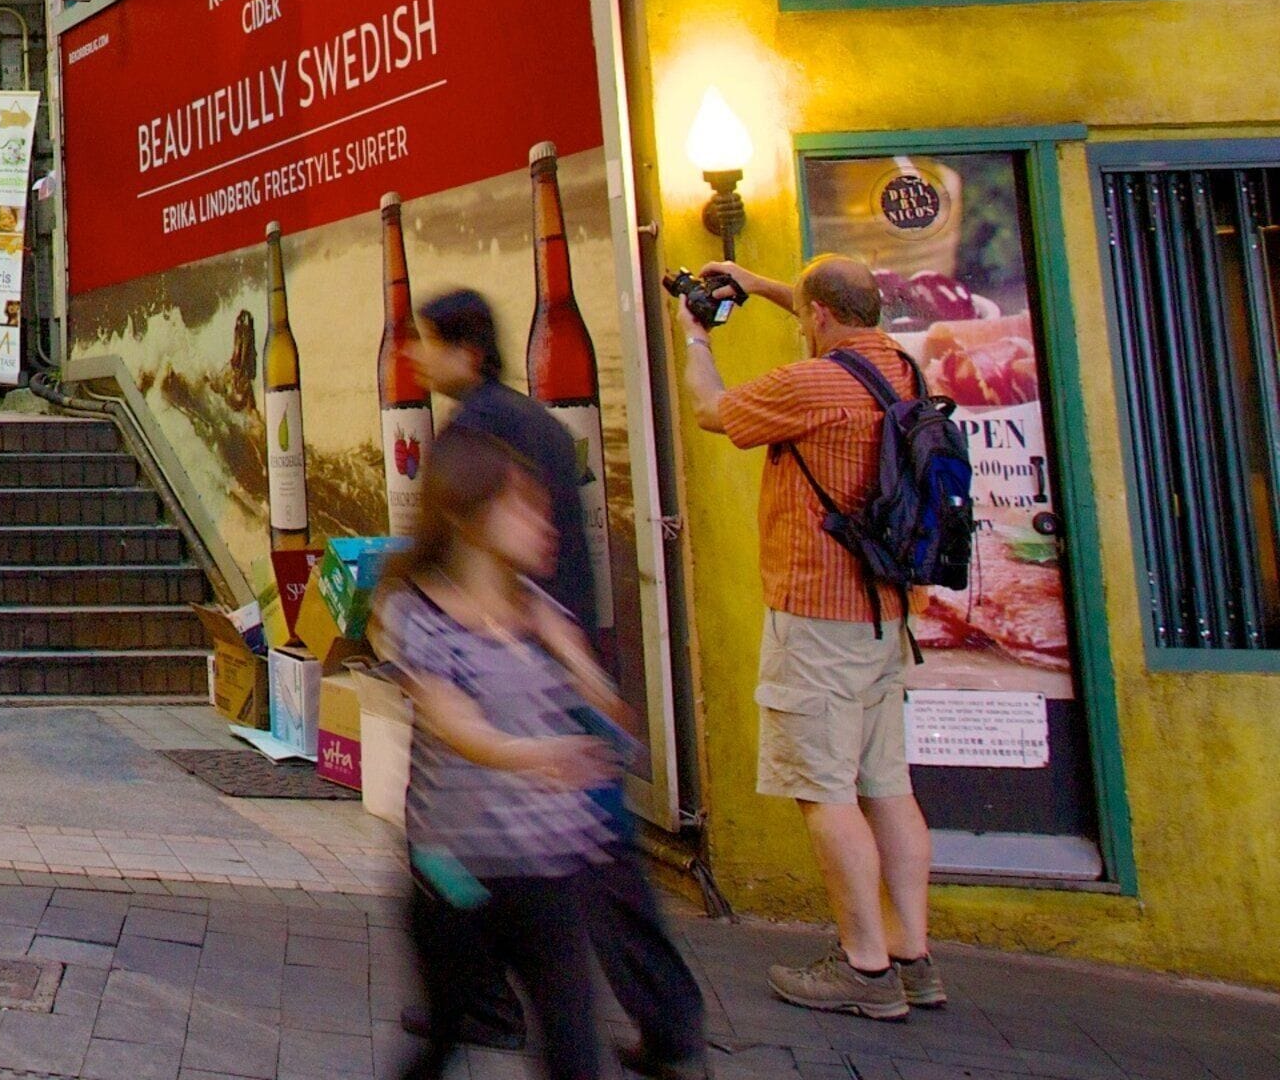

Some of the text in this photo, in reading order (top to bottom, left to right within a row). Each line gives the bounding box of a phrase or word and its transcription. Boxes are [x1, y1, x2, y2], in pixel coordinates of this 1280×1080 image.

[138, 60, 288, 172] BEAUTIFULLY
[163, 125, 409, 234] ERIKA LINDBERG FREESTYLE SURFER
[889, 184, 924, 201] DELI
[900, 197, 918, 210] BY
[888, 206, 936, 222] NICO'S
[958, 419, 1027, 449] PEN
[974, 460, 1034, 481] :00pm
[322, 740, 354, 770] vita
